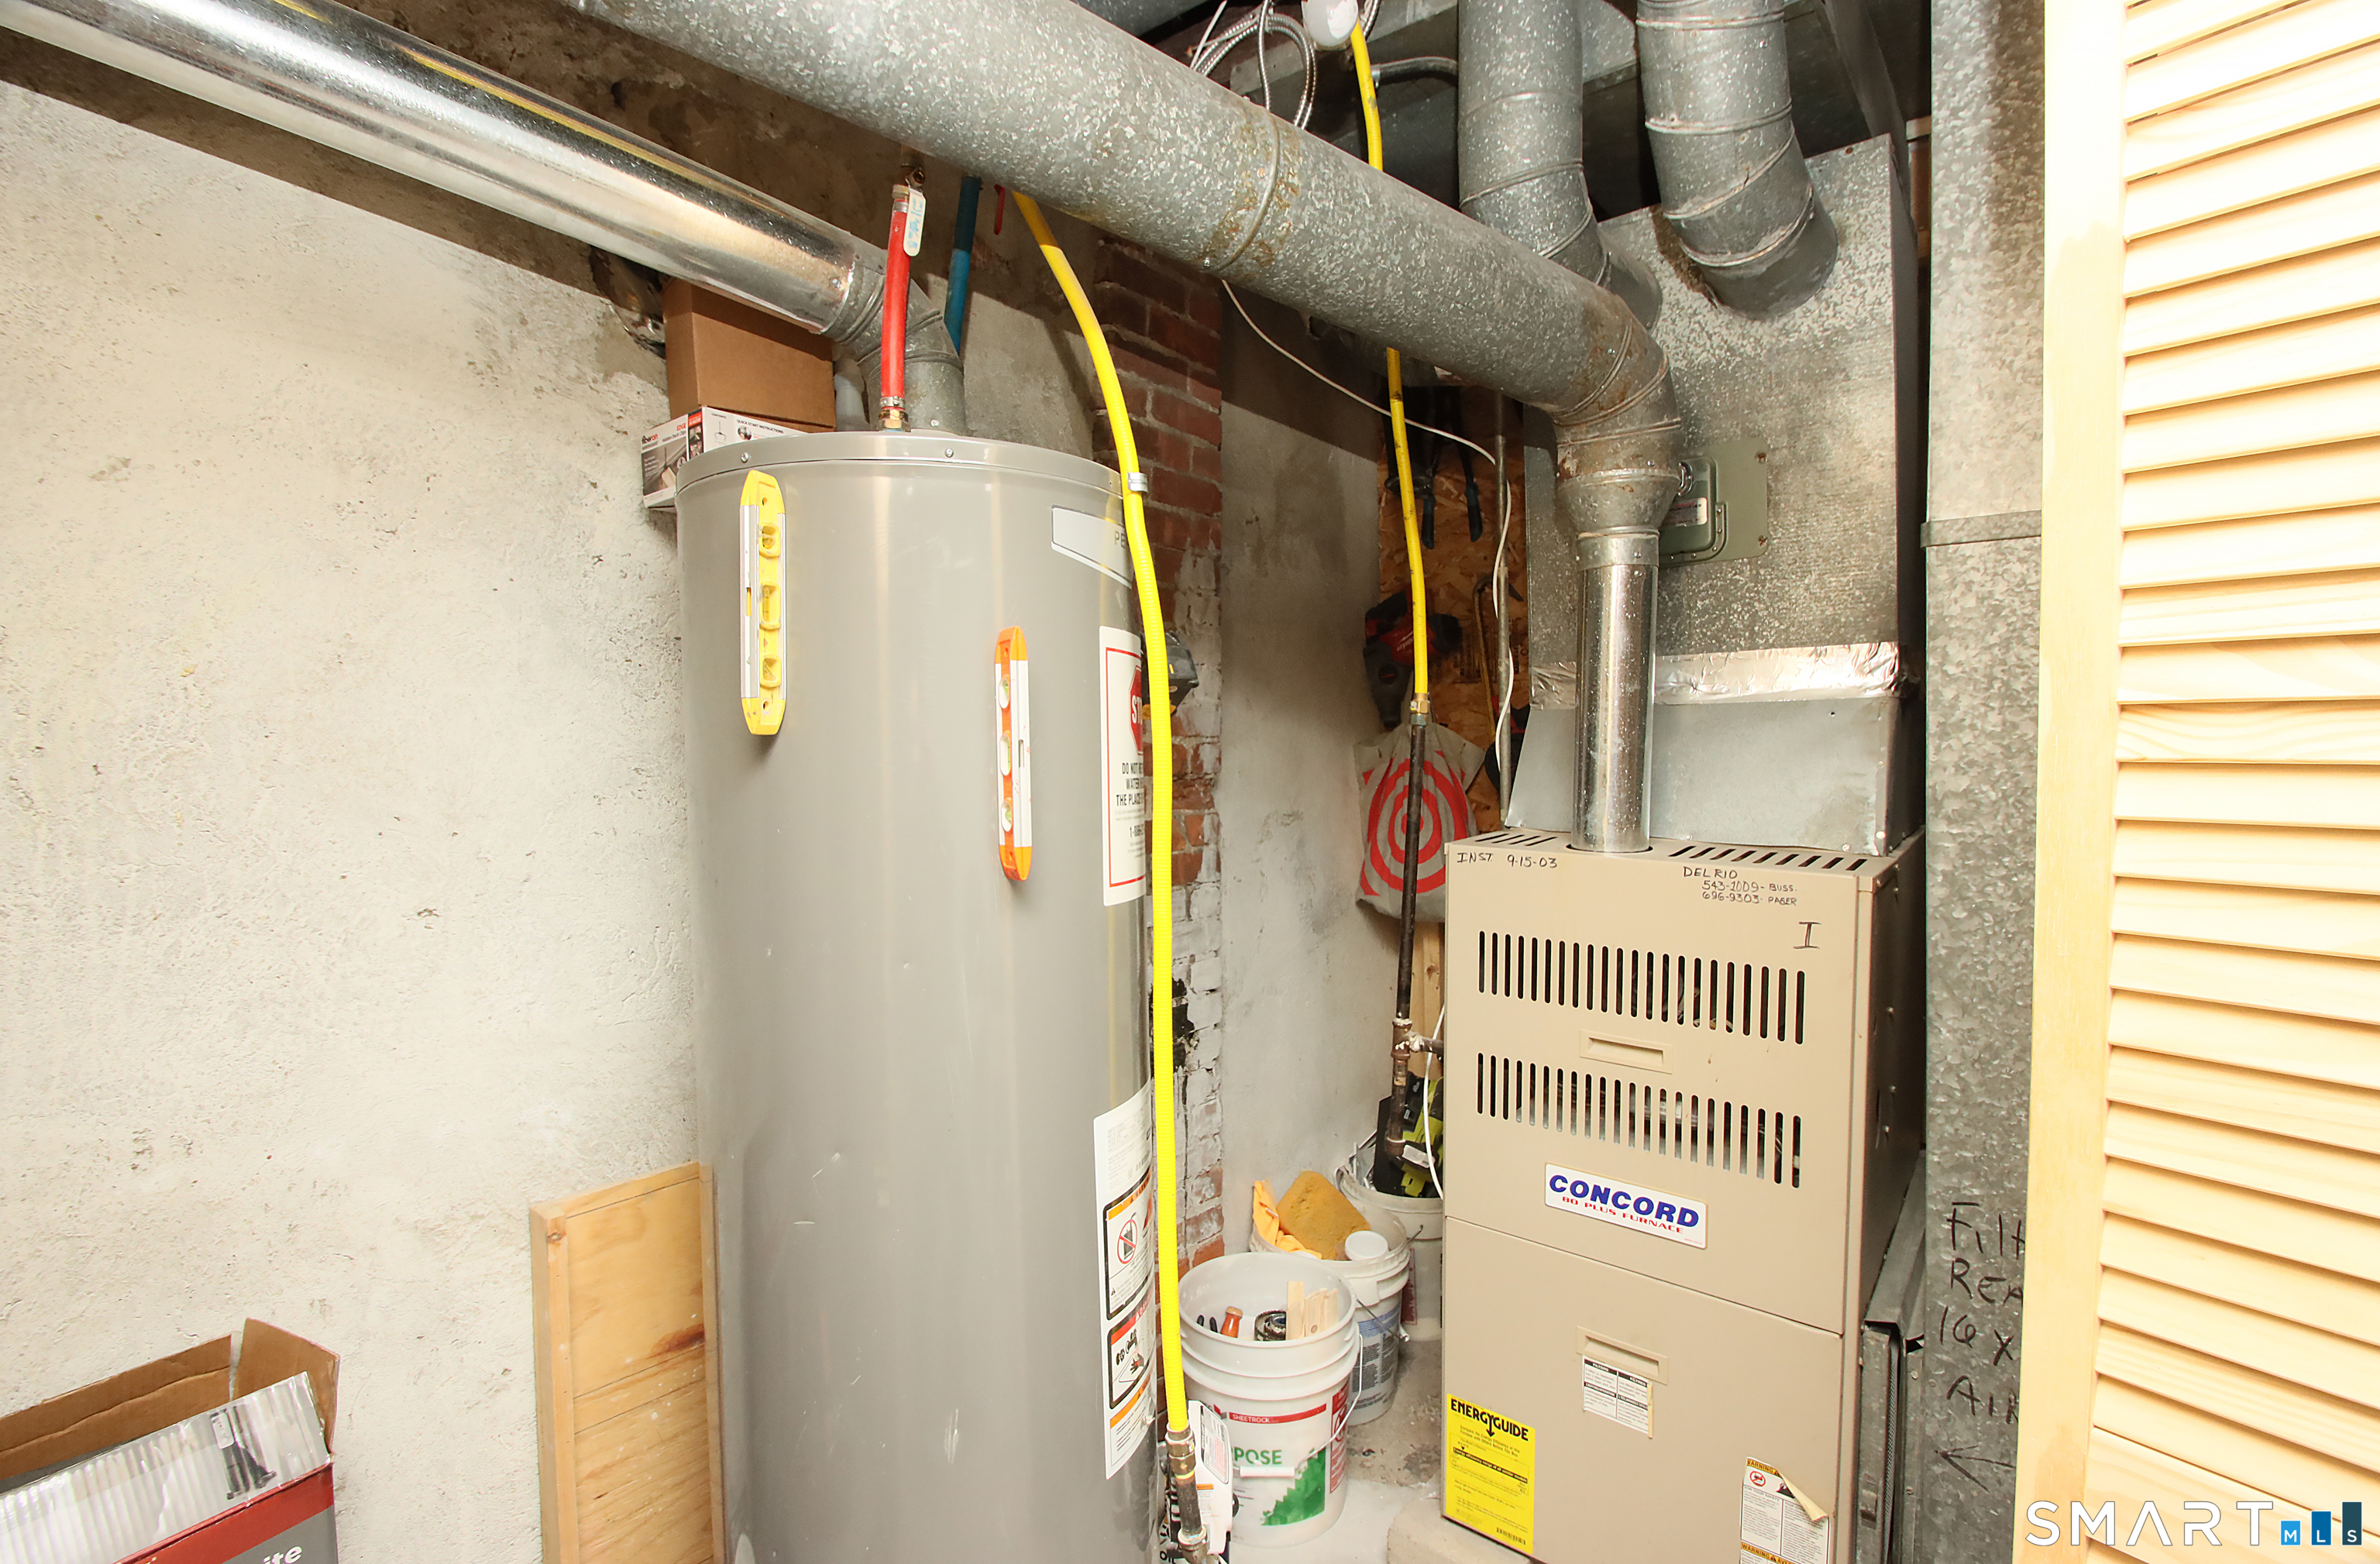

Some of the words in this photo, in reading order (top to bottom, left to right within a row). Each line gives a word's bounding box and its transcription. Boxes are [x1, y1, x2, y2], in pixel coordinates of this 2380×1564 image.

[1116, 794, 1127, 806] THE
[1507, 854, 1557, 868] 9-15-03
[1549, 1174, 1699, 1227] CONCORD
[1584, 1202, 1616, 1216] PLUS
[1622, 1212, 1684, 1234] FURNACE
[1940, 1305, 1976, 1348] 16
[1233, 1414, 1271, 1424] SHEETROCK
[1231, 1446, 1282, 1465] POSE
[1742, 1542, 1770, 1559] WARNING
